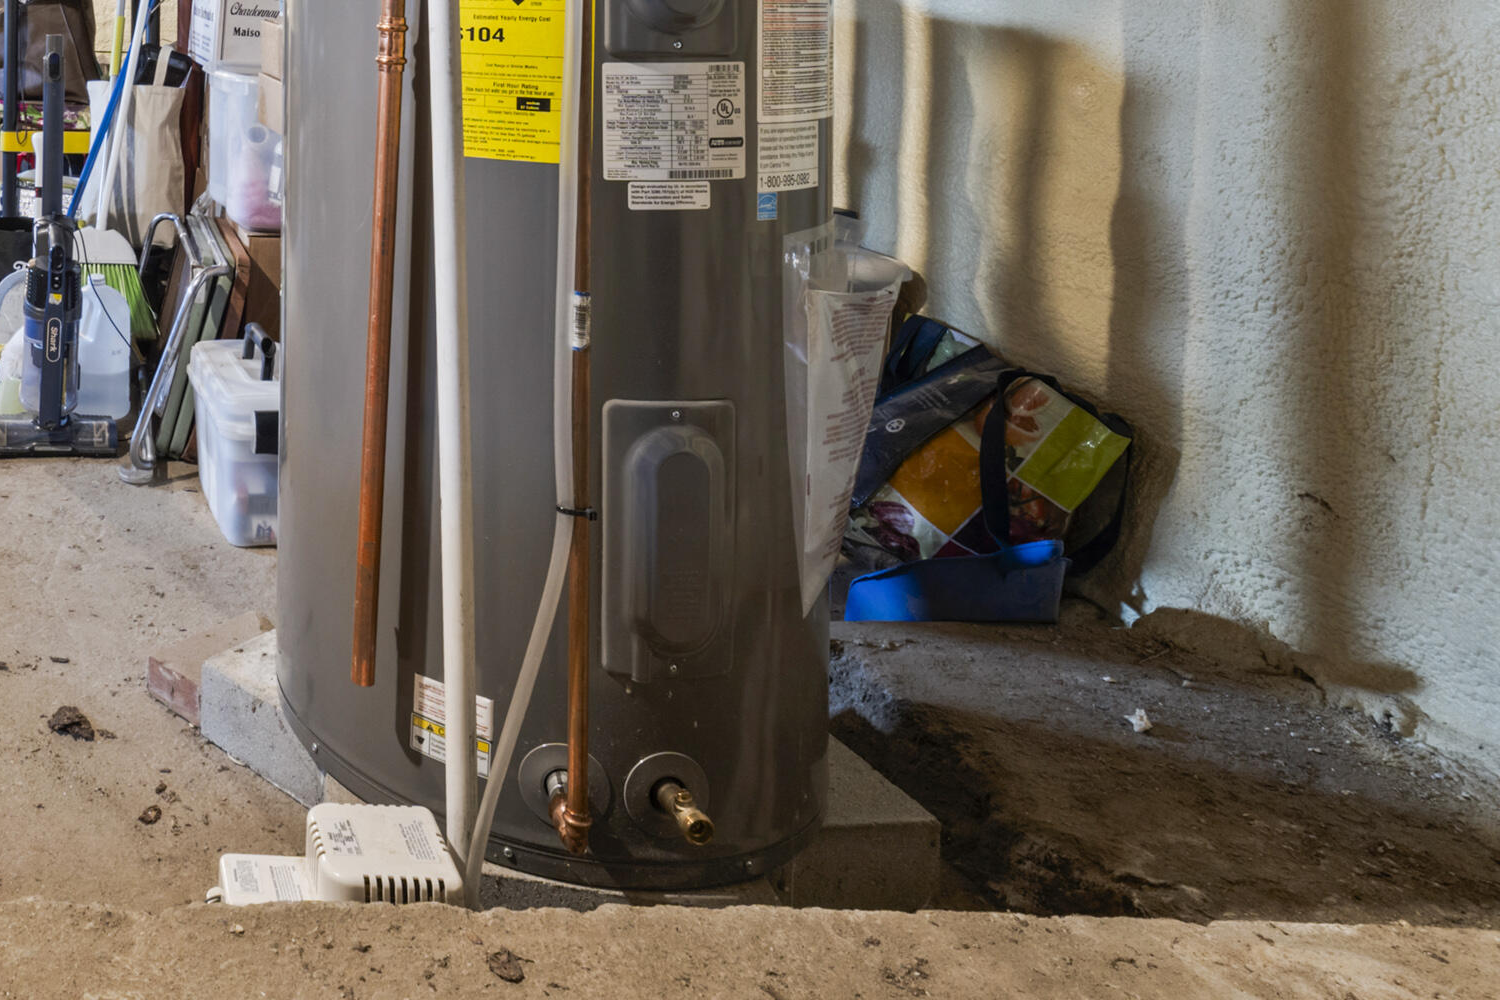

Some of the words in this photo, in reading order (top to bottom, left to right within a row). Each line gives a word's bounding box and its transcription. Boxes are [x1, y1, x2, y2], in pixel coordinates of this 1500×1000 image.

[473, 13, 499, 21] Estimated
[500, 13, 517, 22] Yearly
[518, 13, 538, 23] Energy
[233, 26, 261, 38] Maiso
[720, 102, 730, 115] UL
[50, 326, 59, 353] Shark
